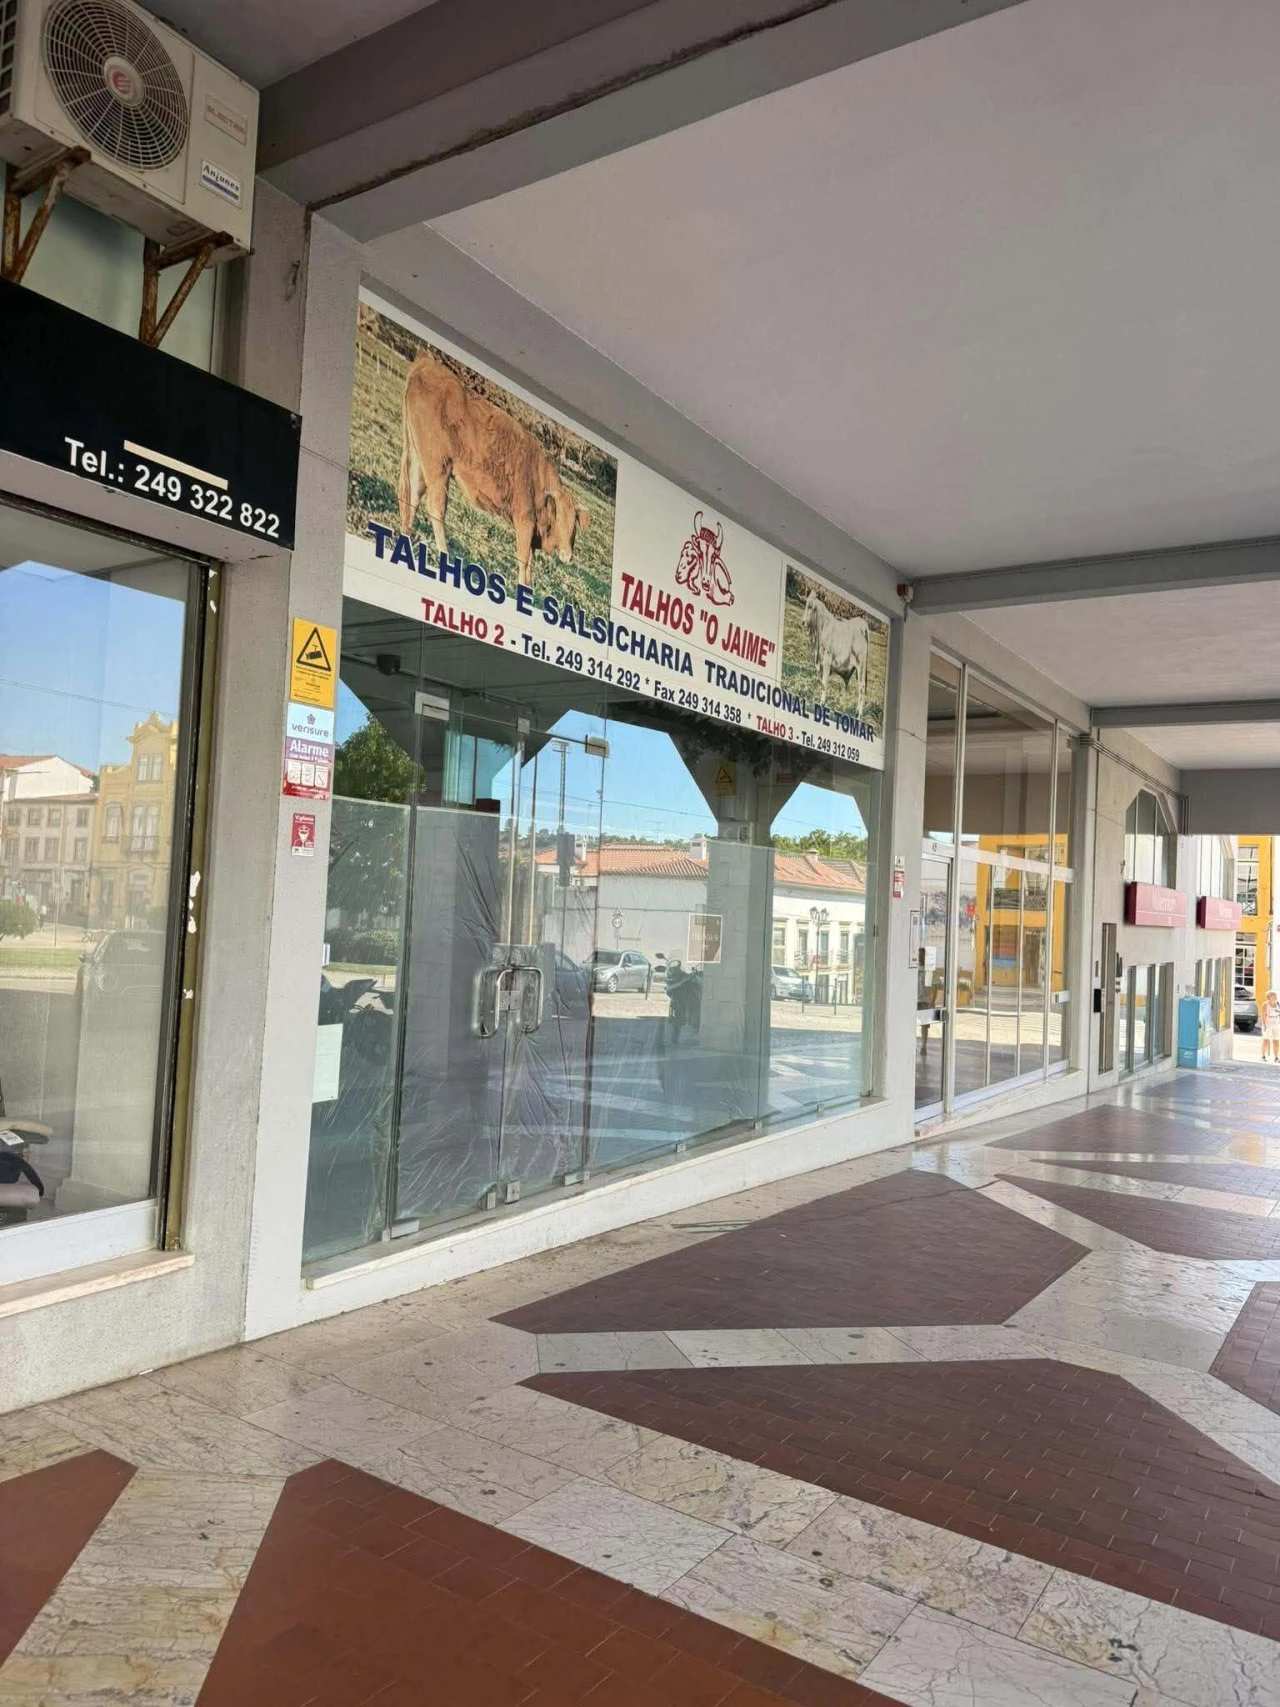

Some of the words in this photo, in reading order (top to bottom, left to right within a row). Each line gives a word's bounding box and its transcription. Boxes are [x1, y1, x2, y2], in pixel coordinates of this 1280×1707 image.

[64, 436, 124, 483] Tel.:
[134, 464, 181, 502] 249
[190, 484, 233, 521] 322
[240, 502, 280, 539] 822
[367, 520, 506, 605] TALHOS
[516, 584, 534, 617] E
[543, 595, 693, 677] SALSICHARIA
[705, 659, 809, 719] TRADICIONAL
[814, 703, 831, 727] DE
[834, 713, 875, 743] TOMAR
[621, 572, 695, 636] TALHOS
[700, 609, 718, 645] "O
[721, 621, 776, 668] JAIME"
[421, 597, 488, 640] TALHO
[493, 624, 504, 646] 2
[521, 633, 550, 662] Tel.
[555, 645, 582, 672] 249
[588, 657, 613, 683] 314
[617, 668, 640, 692] 292
[654, 681, 675, 703] Fax
[678, 688, 699, 710] 249
[702, 698, 721, 717] 314
[723, 704, 741, 723] 358
[756, 715, 786, 738] TALHO
[788, 726, 794, 741] 3
[801, 730, 815, 747] Tel.
[817, 736, 831, 752] 249
[833, 740, 846, 757] 312
[847, 746, 860, 761] 059
[290, 739, 329, 757] Alarme
[292, 724, 329, 737] verisure
